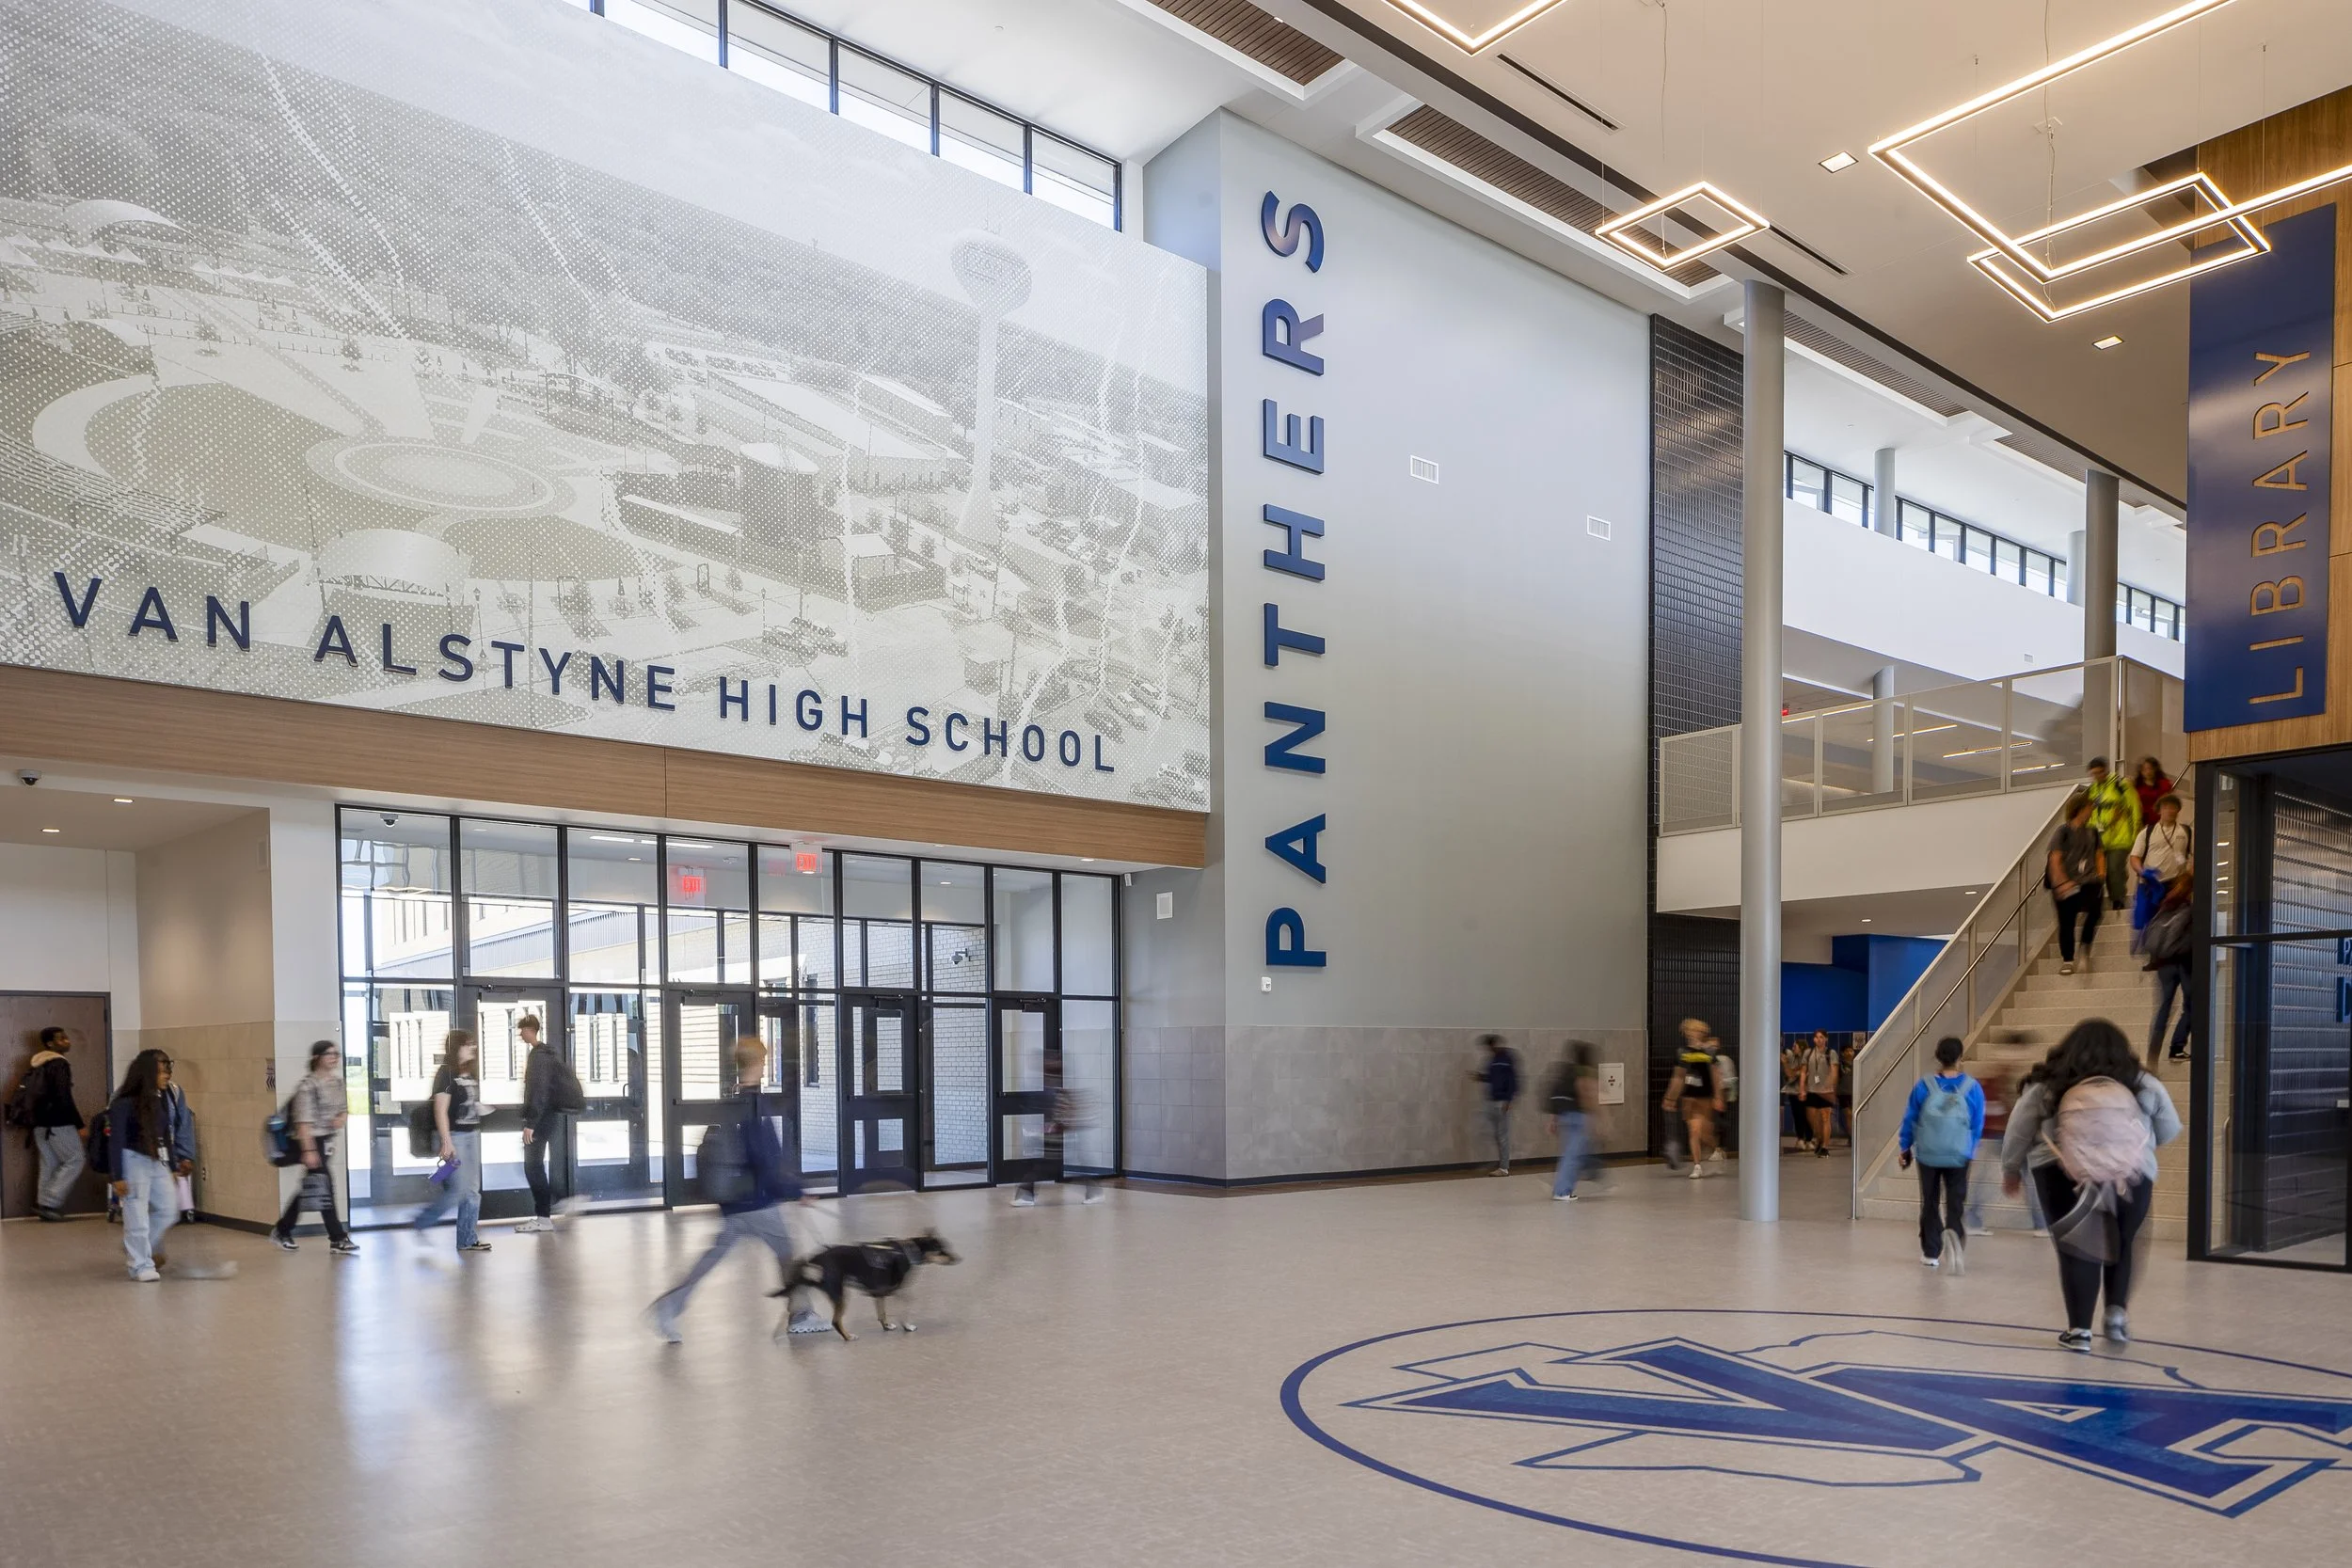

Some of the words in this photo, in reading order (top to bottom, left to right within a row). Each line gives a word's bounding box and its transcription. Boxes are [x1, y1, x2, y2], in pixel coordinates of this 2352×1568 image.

[1261, 190, 1327, 970] PANTHERS
[2248, 350, 2311, 705] LIBRARY
[54, 571, 250, 651] VAN
[313, 615, 676, 711] ALSTYNE
[719, 675, 868, 738] HIGH
[905, 705, 1115, 772] SCHOOL
[797, 854, 817, 871] EXIT
